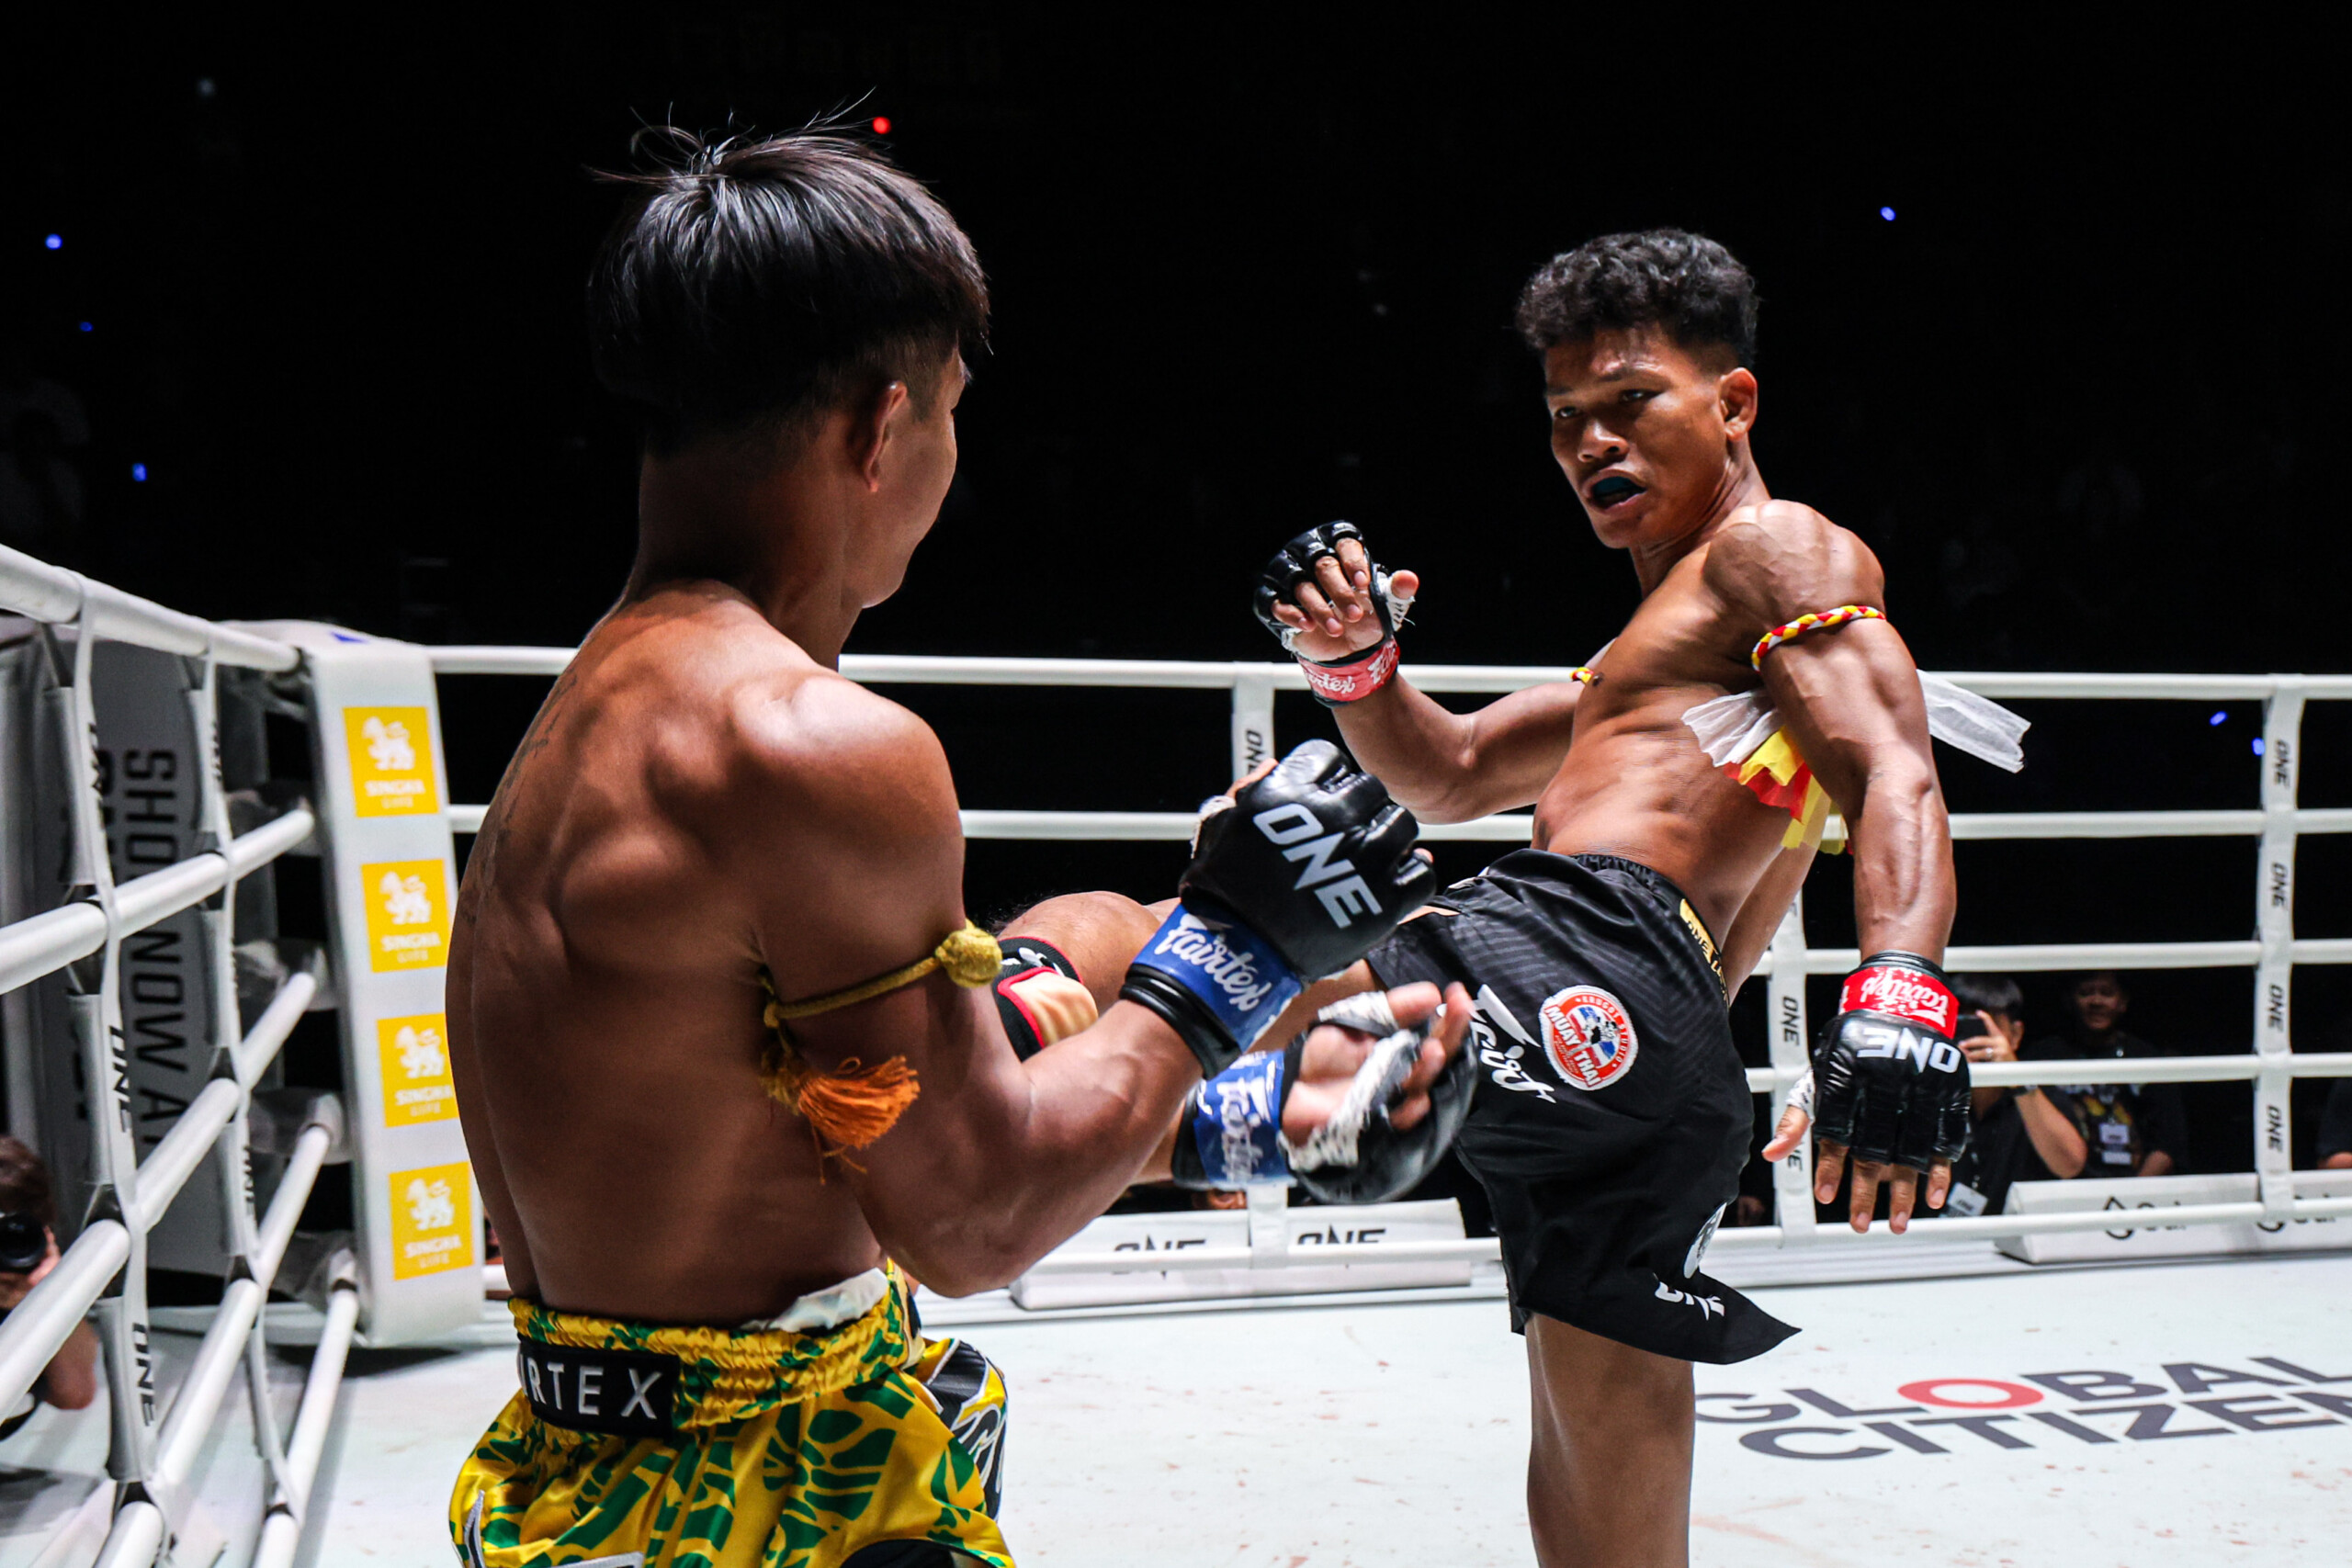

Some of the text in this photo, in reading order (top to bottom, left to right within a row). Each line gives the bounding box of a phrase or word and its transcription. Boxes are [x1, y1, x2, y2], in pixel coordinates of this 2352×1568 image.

[2275, 739, 2291, 787] ONE
[124, 749, 182, 878] SHO
[1252, 803, 1384, 930] ONE
[2271, 862, 2289, 908] ONE
[1154, 912, 1272, 1011] Fairtex
[130, 930, 189, 1072] NOW
[1781, 996, 1800, 1046] ONE
[2268, 984, 2286, 1033] ONE
[1544, 1005, 1581, 1046] MUAY
[1574, 1050, 1602, 1086] THAI
[1857, 1027, 1962, 1074] ONE
[2266, 1105, 2283, 1153] ONE
[1694, 1357, 2352, 1425] GLOBAL
